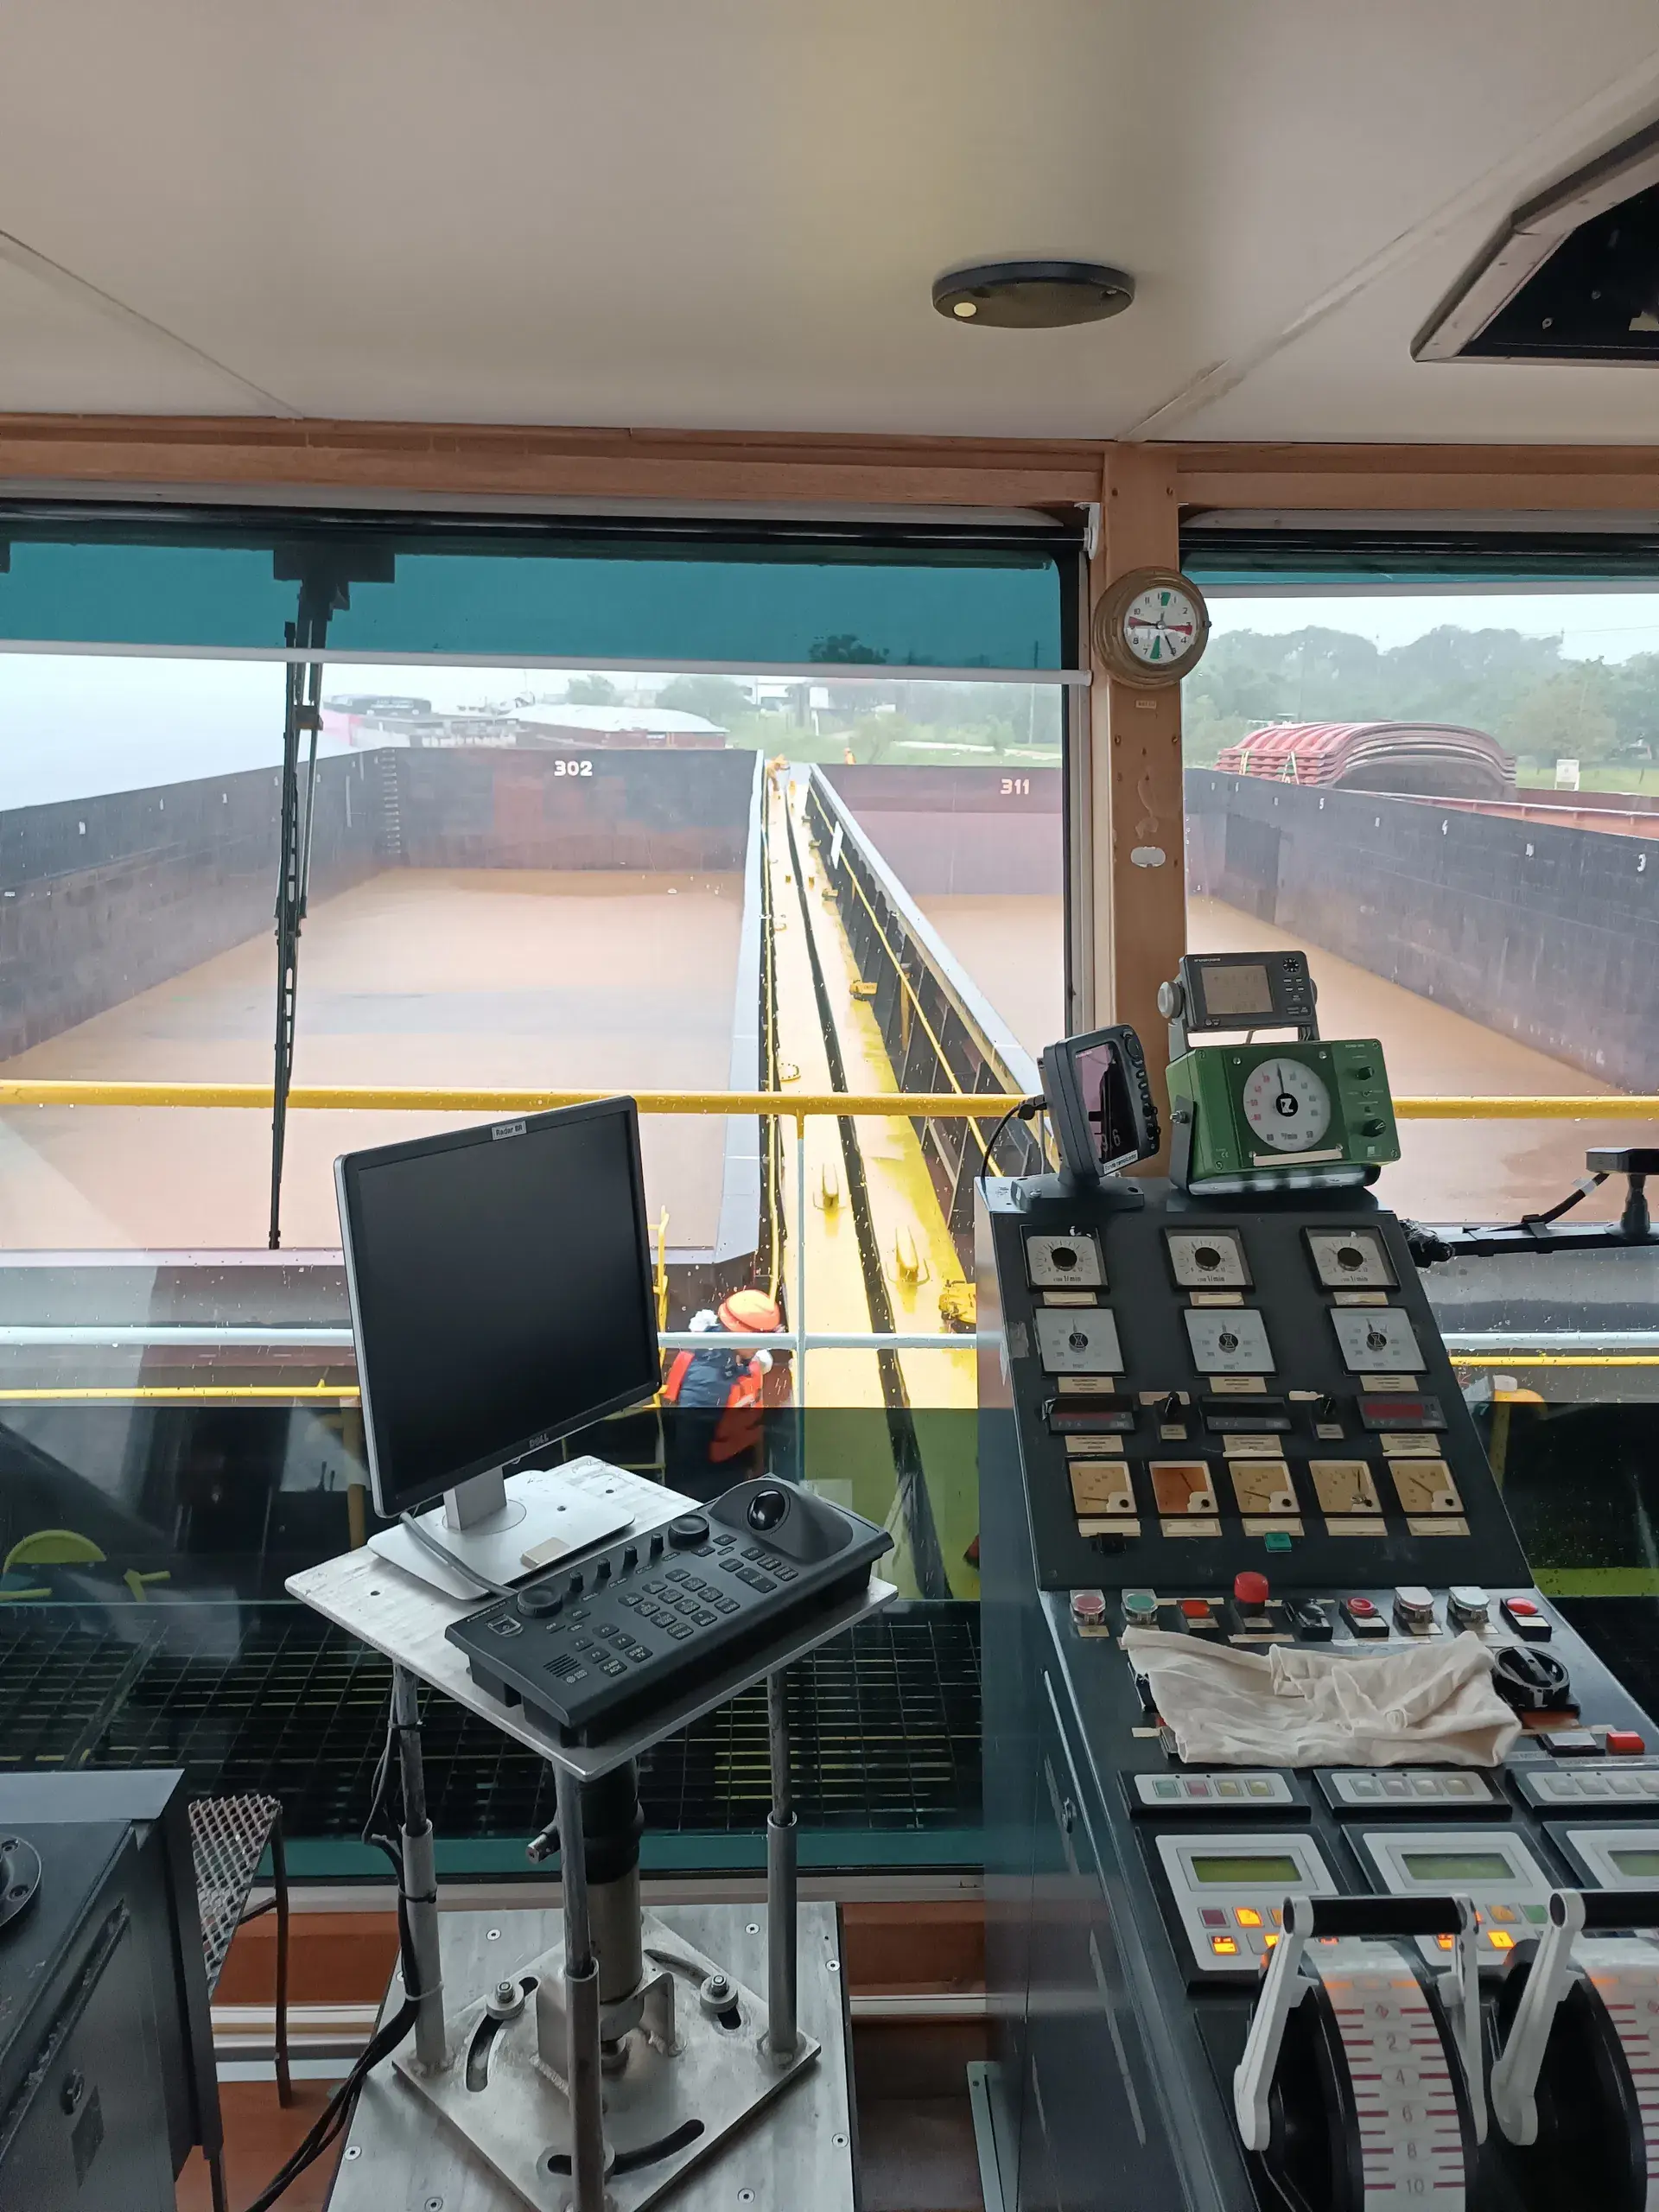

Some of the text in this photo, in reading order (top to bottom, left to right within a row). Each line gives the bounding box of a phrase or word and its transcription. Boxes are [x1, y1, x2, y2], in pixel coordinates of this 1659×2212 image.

[1145, 596, 1150, 605] 11
[554, 760, 593, 777] 302
[1001, 779, 1029, 794] 311
[1637, 854, 1646, 872] 3
[1386, 2032, 1399, 2052] 2
[1395, 2069, 1406, 2087] 4
[1402, 2104, 1413, 2123] 6
[1407, 2141, 1417, 2160] 8
[1407, 2177, 1425, 2196] 10
